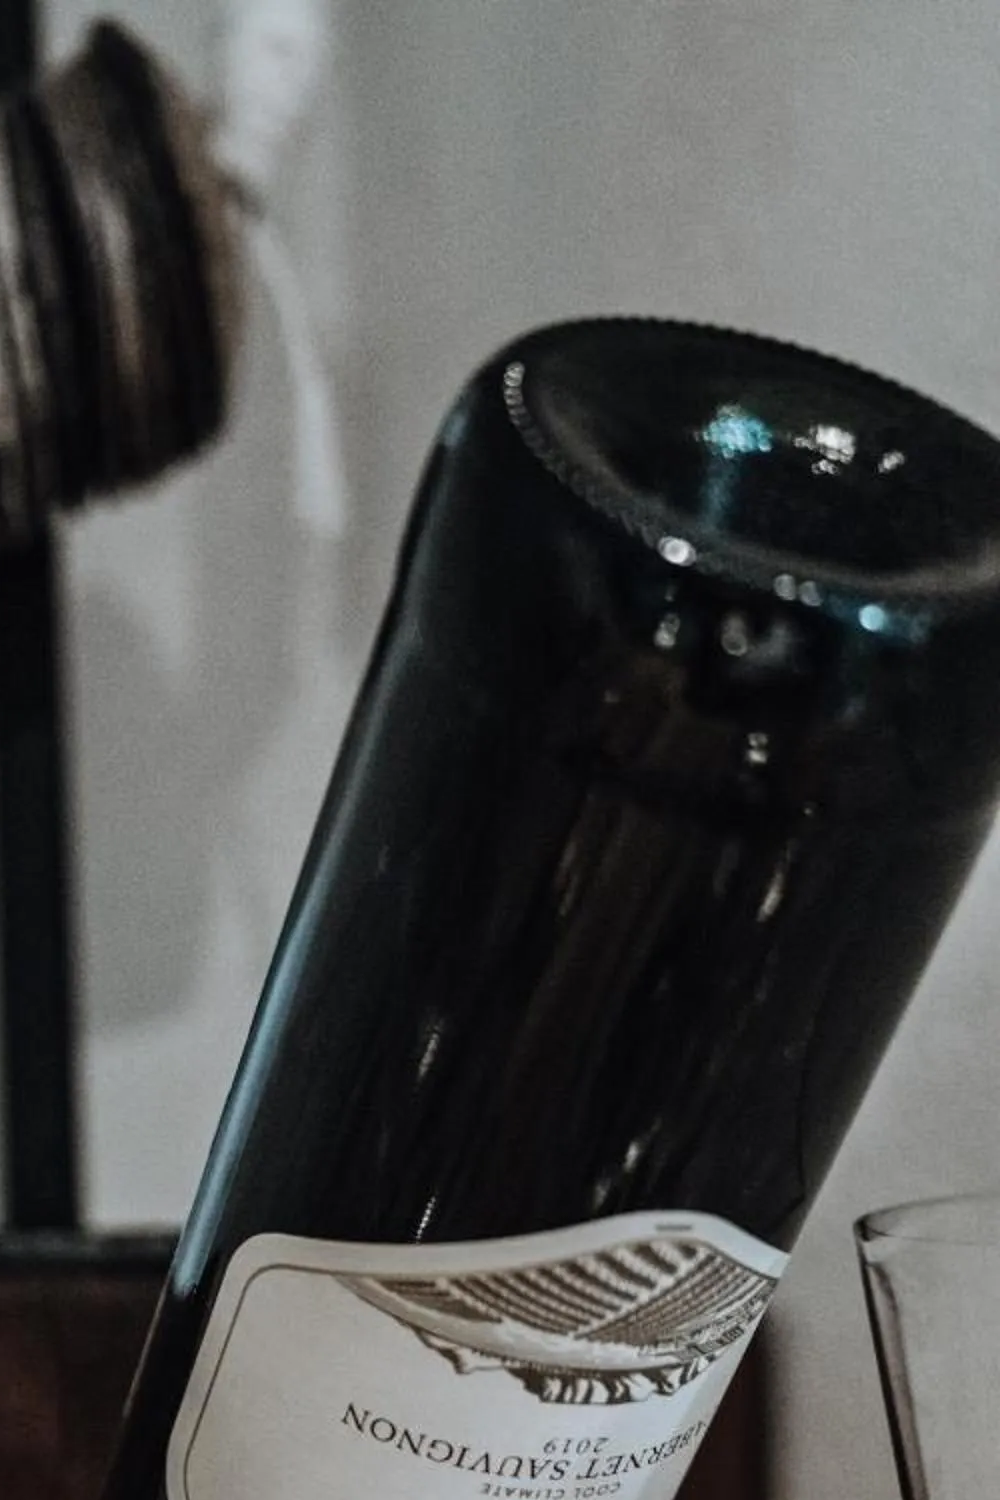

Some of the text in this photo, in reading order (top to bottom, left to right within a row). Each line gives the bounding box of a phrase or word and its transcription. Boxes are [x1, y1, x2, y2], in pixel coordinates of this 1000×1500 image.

[341, 1402, 708, 1481] ABERNET SAUVIGNON
[543, 1437, 610, 1455] 2019
[481, 1481, 622, 1500] COOL CLIMATE
